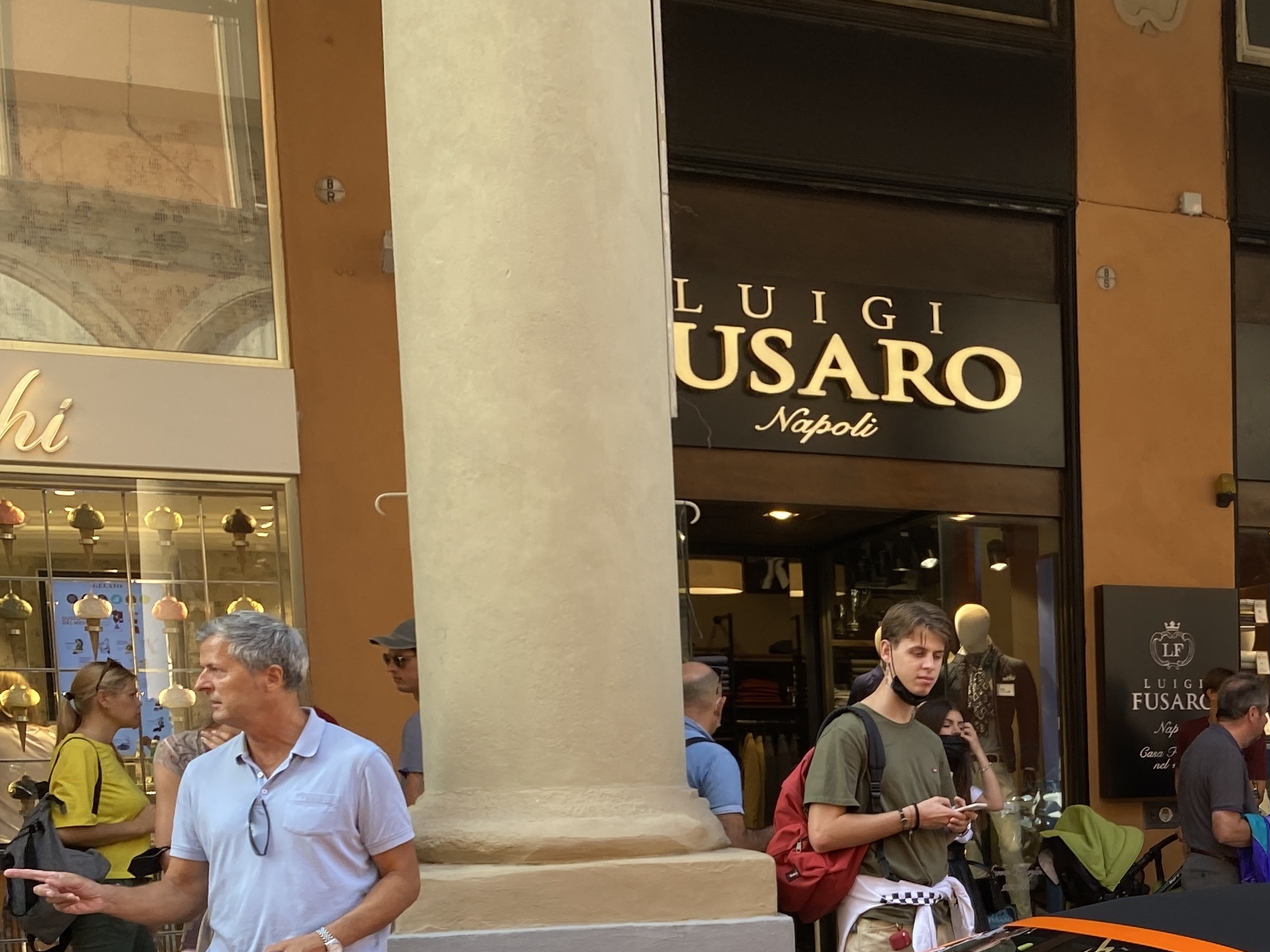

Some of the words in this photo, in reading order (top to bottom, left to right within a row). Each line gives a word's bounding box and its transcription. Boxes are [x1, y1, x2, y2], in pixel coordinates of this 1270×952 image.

[673, 277, 943, 334] LUIGI
[0, 368, 73, 453] hi
[755, 406, 878, 443] Napoli
[1162, 643, 1184, 657] LF
[1144, 679, 1203, 689] LUIGI
[1140, 746, 1164, 758] Casa
